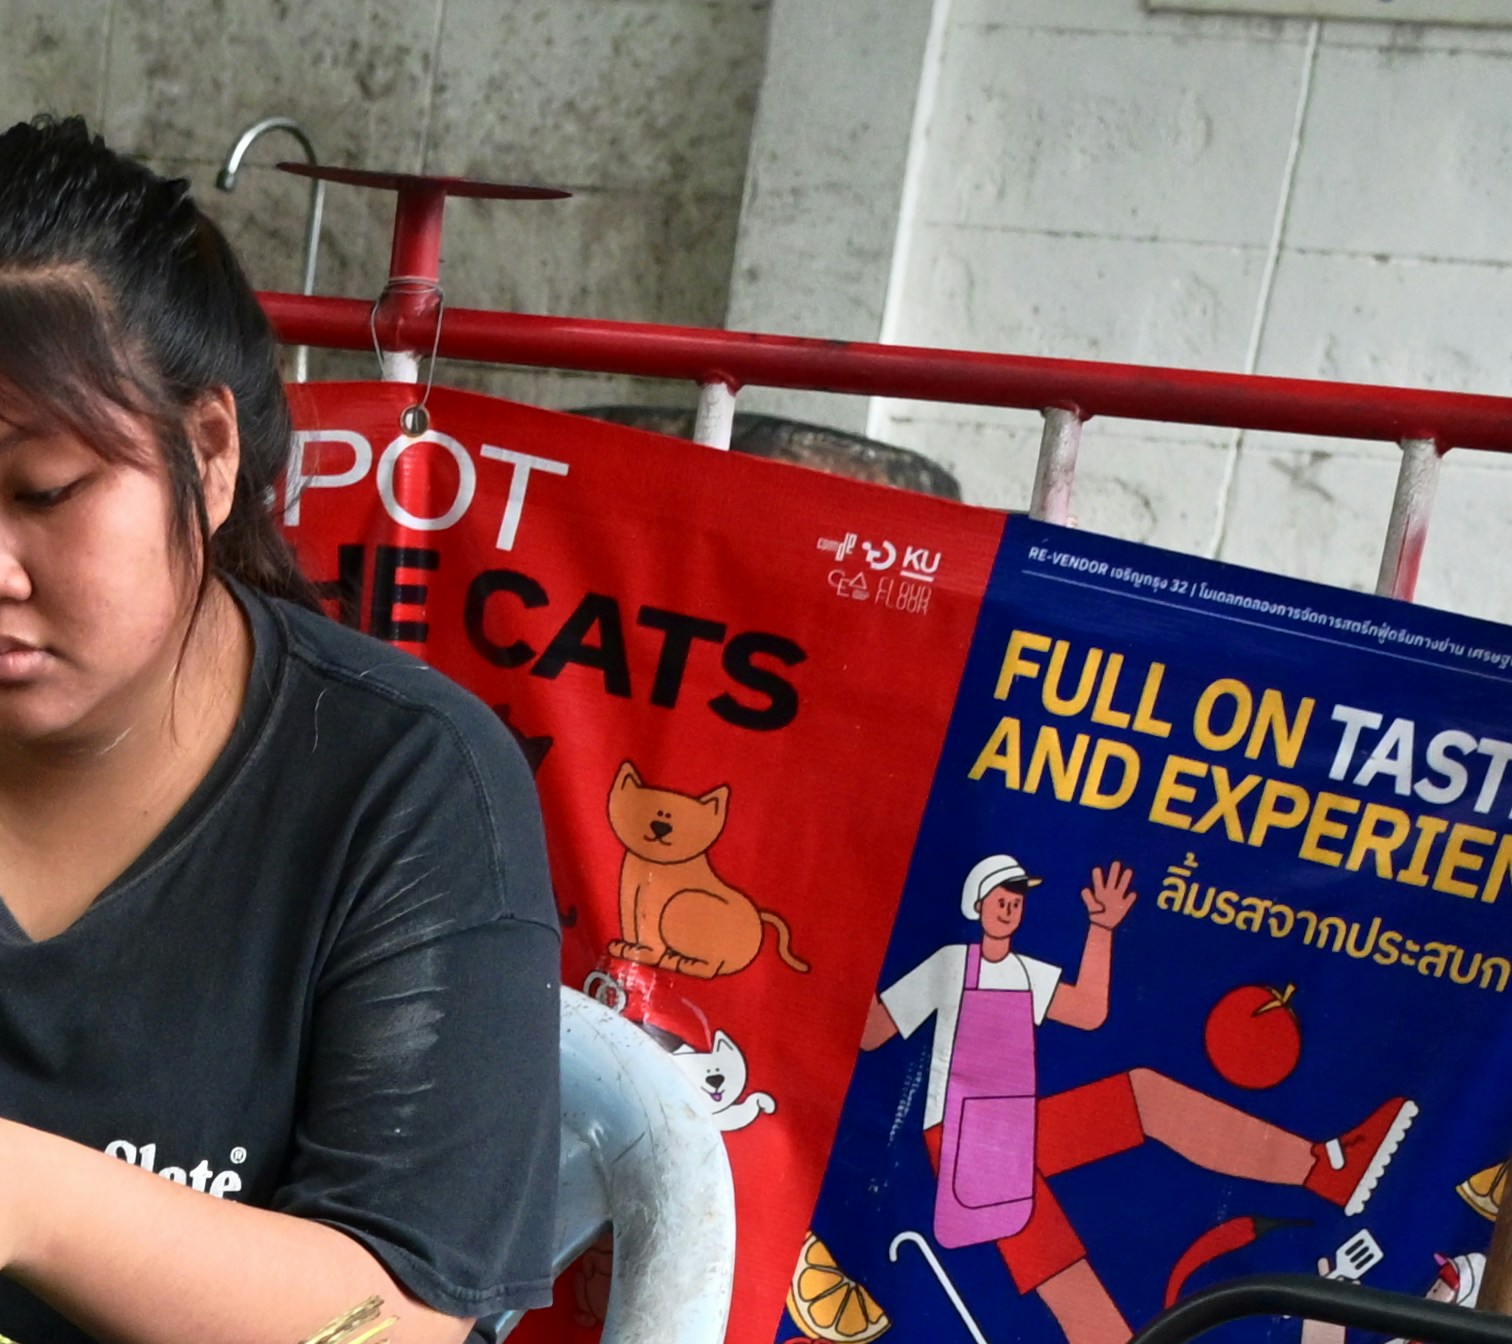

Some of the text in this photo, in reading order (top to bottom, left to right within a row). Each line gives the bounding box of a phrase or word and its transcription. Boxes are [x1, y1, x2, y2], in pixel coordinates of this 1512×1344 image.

[270, 430, 569, 551] POT
[902, 545, 941, 573] KU
[1029, 547, 1109, 576] RE-VENDOR
[1109, 564, 1168, 595] เจริญกรุง
[1170, 579, 1188, 595] 32
[301, 544, 807, 731] HE CATS
[993, 630, 1173, 738] FULL
[1193, 678, 1316, 768] ON
[968, 717, 1142, 811] AND
